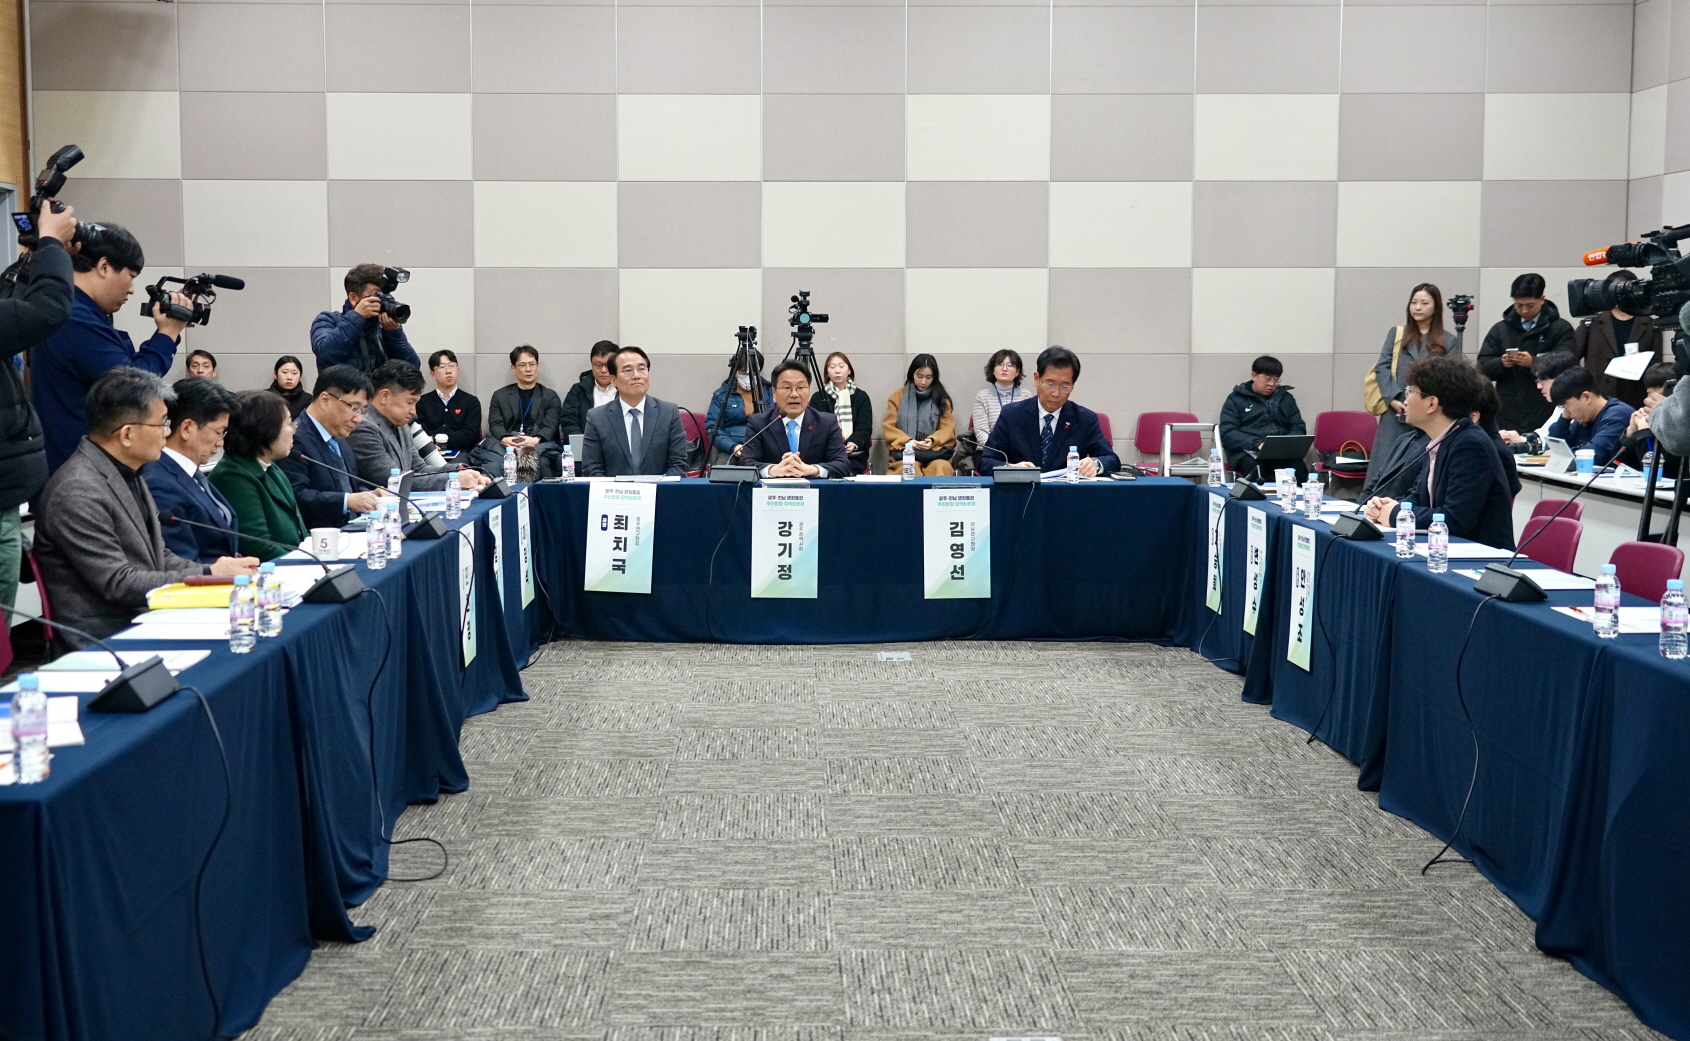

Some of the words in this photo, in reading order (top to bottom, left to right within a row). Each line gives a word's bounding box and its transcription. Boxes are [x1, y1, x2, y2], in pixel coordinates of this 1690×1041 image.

[320, 538, 328, 549] 5
[612, 514, 628, 574] 최치국
[778, 521, 793, 580] 강기정
[950, 521, 964, 580] 김영선
